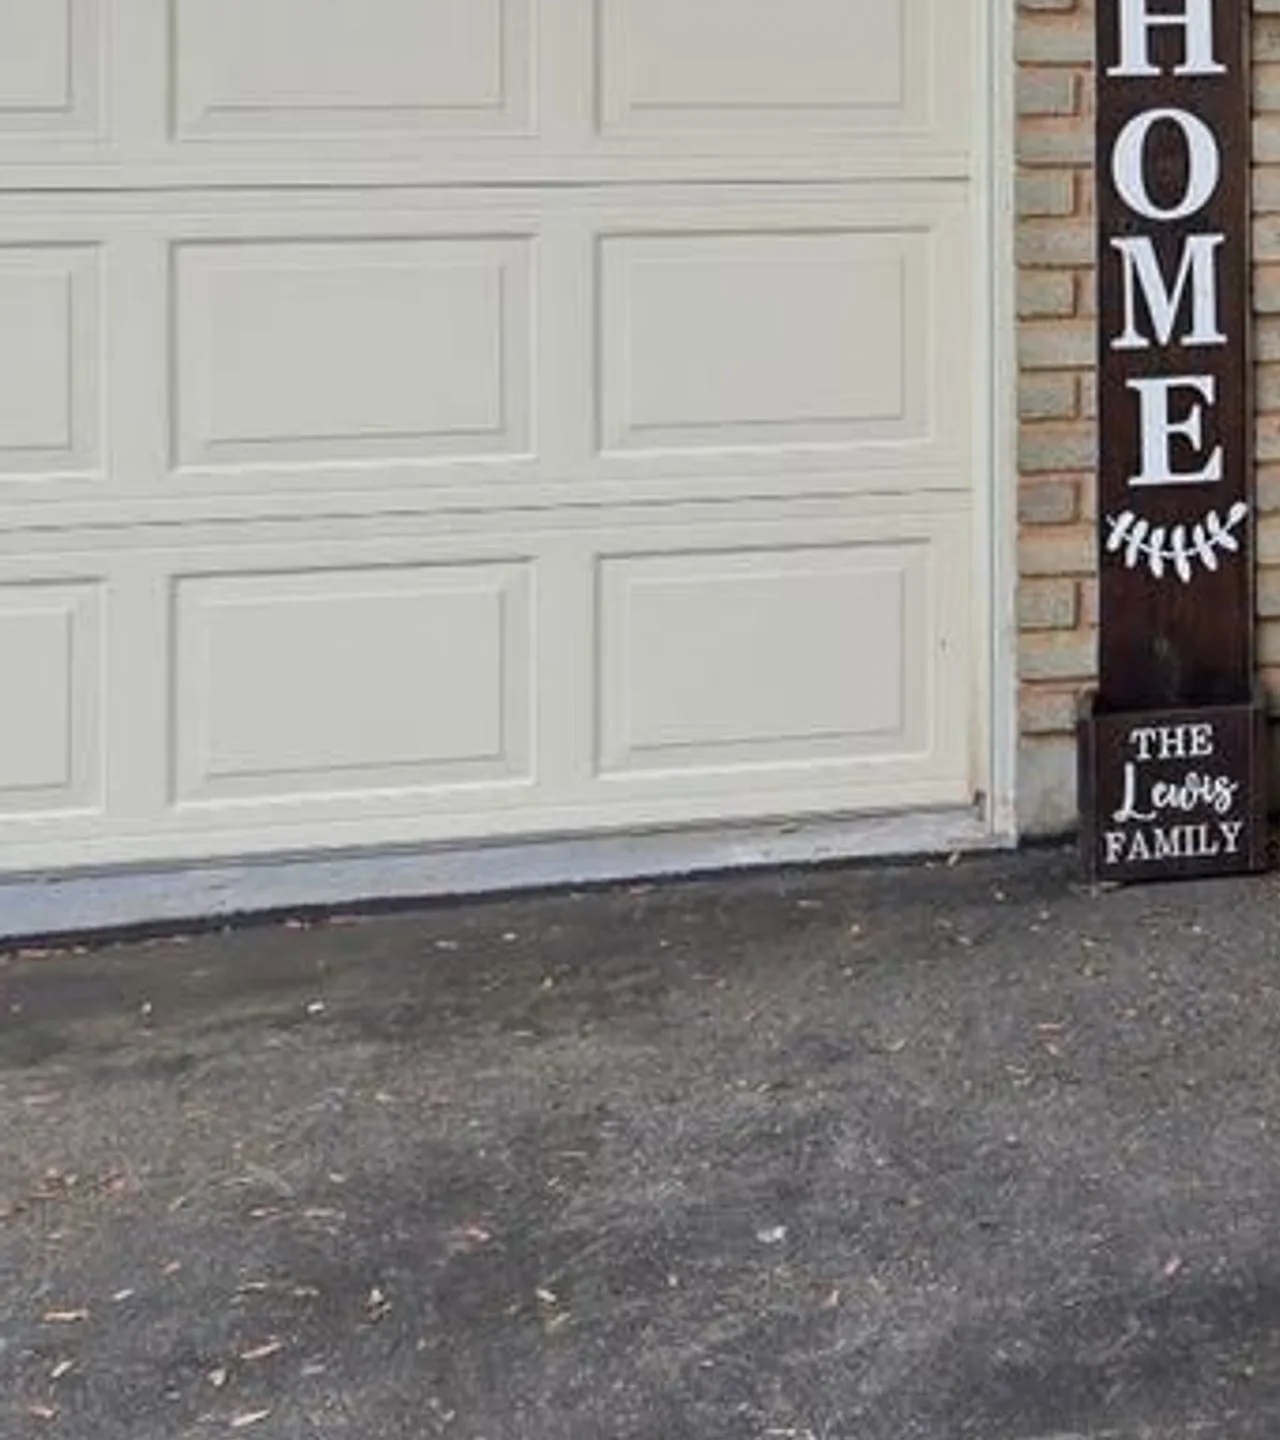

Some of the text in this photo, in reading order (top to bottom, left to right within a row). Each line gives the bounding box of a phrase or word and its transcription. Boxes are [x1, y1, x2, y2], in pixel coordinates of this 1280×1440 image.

[1129, 722, 1213, 761] THE
[1112, 761, 1239, 822] Lewis
[1105, 820, 1242, 864] FAMILY
